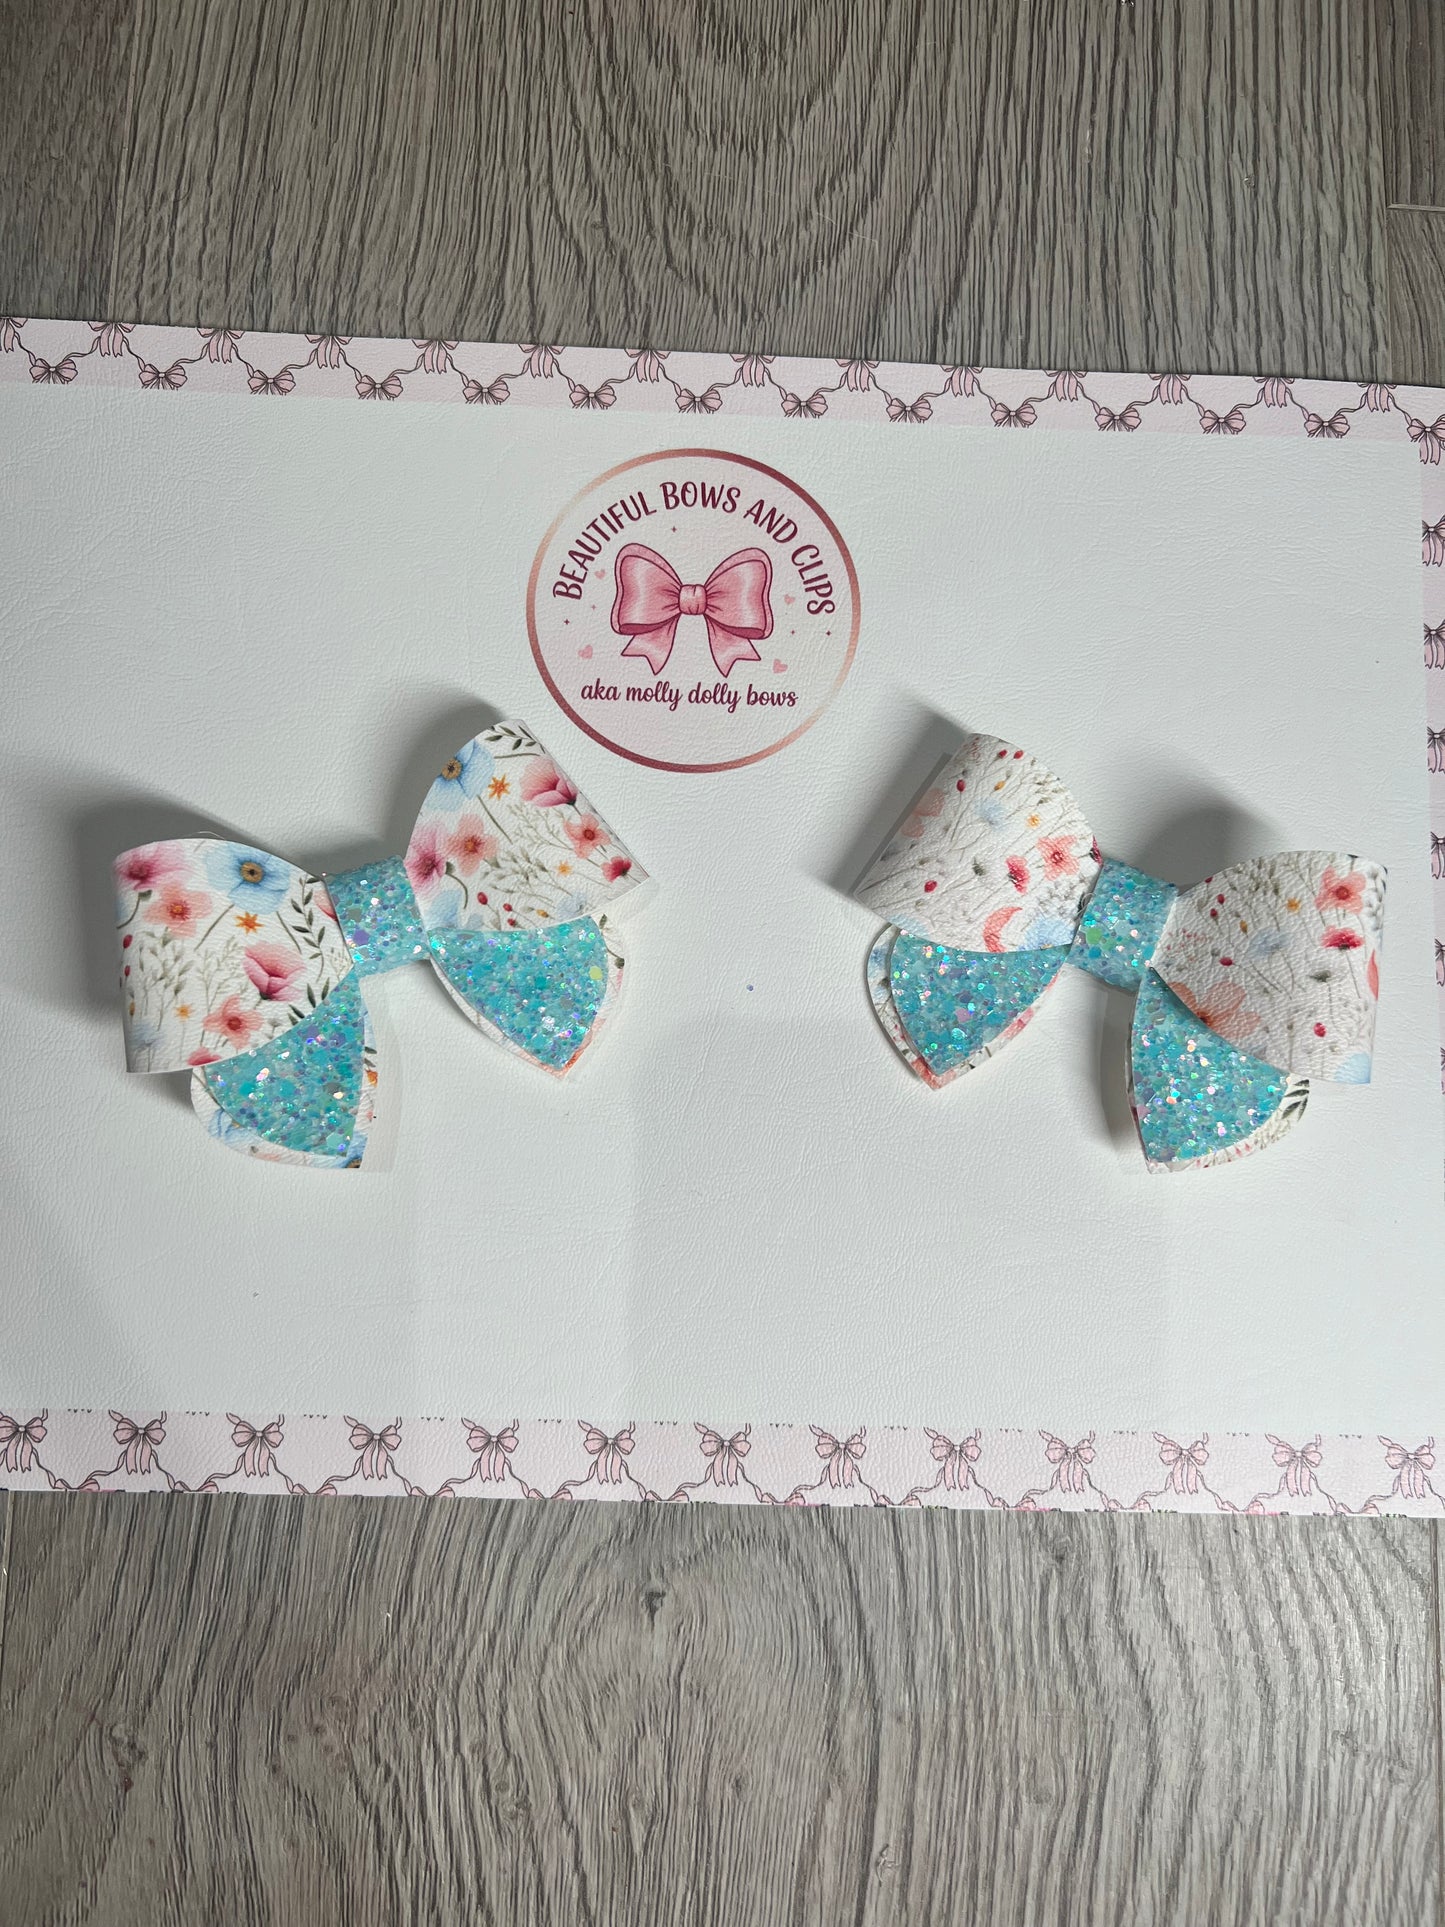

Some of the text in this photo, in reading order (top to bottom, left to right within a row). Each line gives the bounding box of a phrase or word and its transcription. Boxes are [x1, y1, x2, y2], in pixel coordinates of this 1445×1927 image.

[552, 481, 835, 615] BEAUTIFUL BOWS AND CLIPS
[581, 678, 799, 713] aka molly dolly bows
